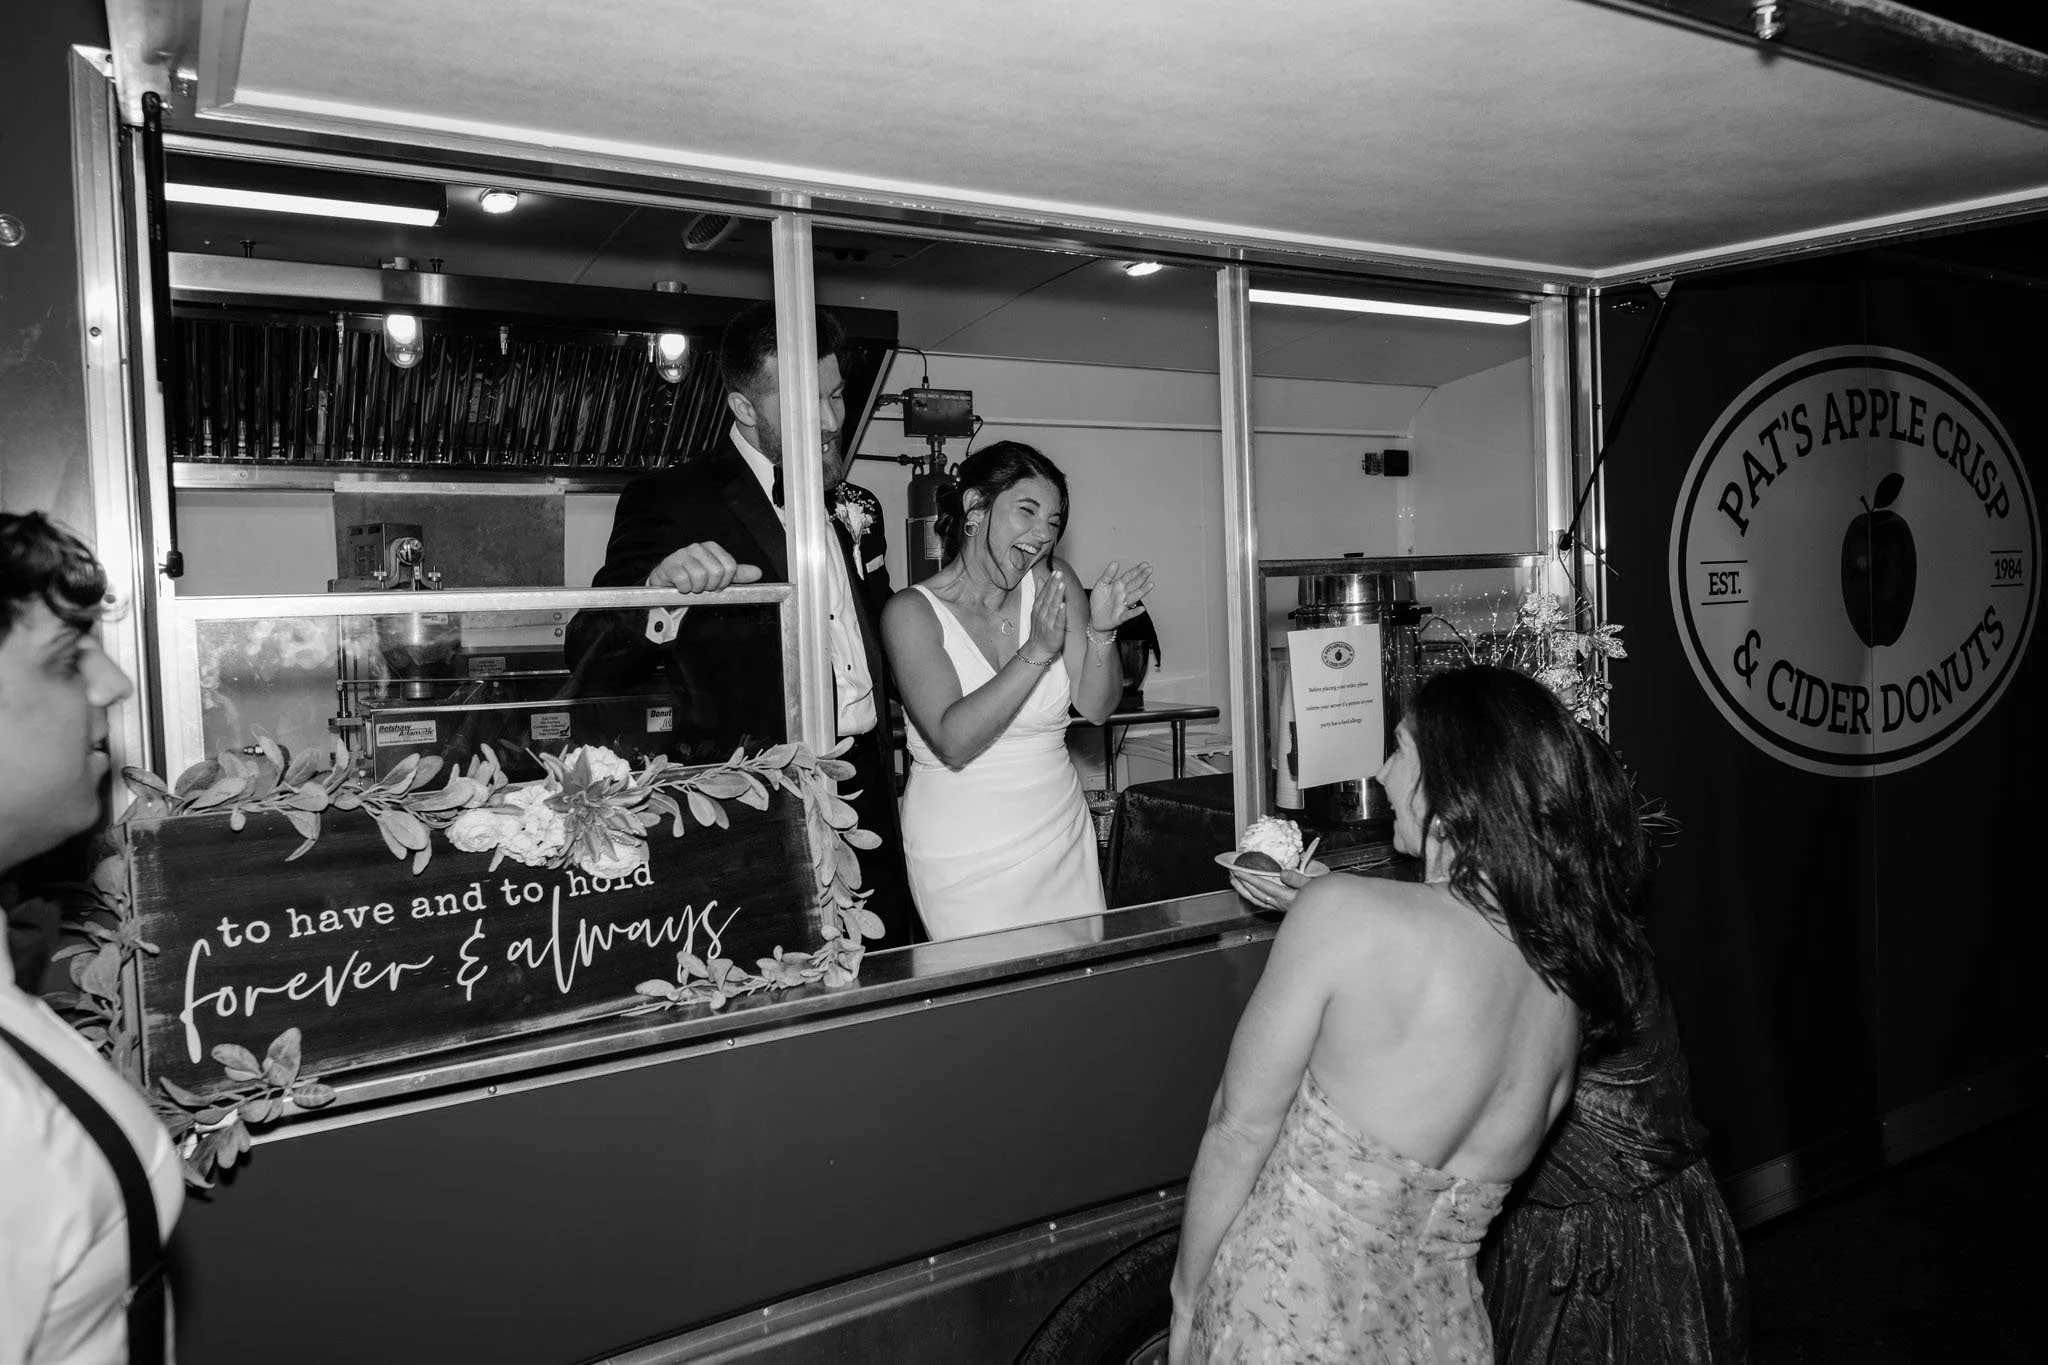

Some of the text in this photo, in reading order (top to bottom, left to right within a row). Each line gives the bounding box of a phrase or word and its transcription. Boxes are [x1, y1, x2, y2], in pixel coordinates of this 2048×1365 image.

[1717, 388, 2010, 538] PAT'S APPLE CRISP
[1708, 571, 1742, 596] EST.
[1994, 558, 2023, 580] 1984
[1733, 604, 2005, 735] & CIDER DONUTS
[216, 916, 271, 948] to
[286, 903, 395, 939] have
[411, 883, 487, 919] and
[500, 878, 544, 906] to
[179, 886, 742, 1064] forever & always
